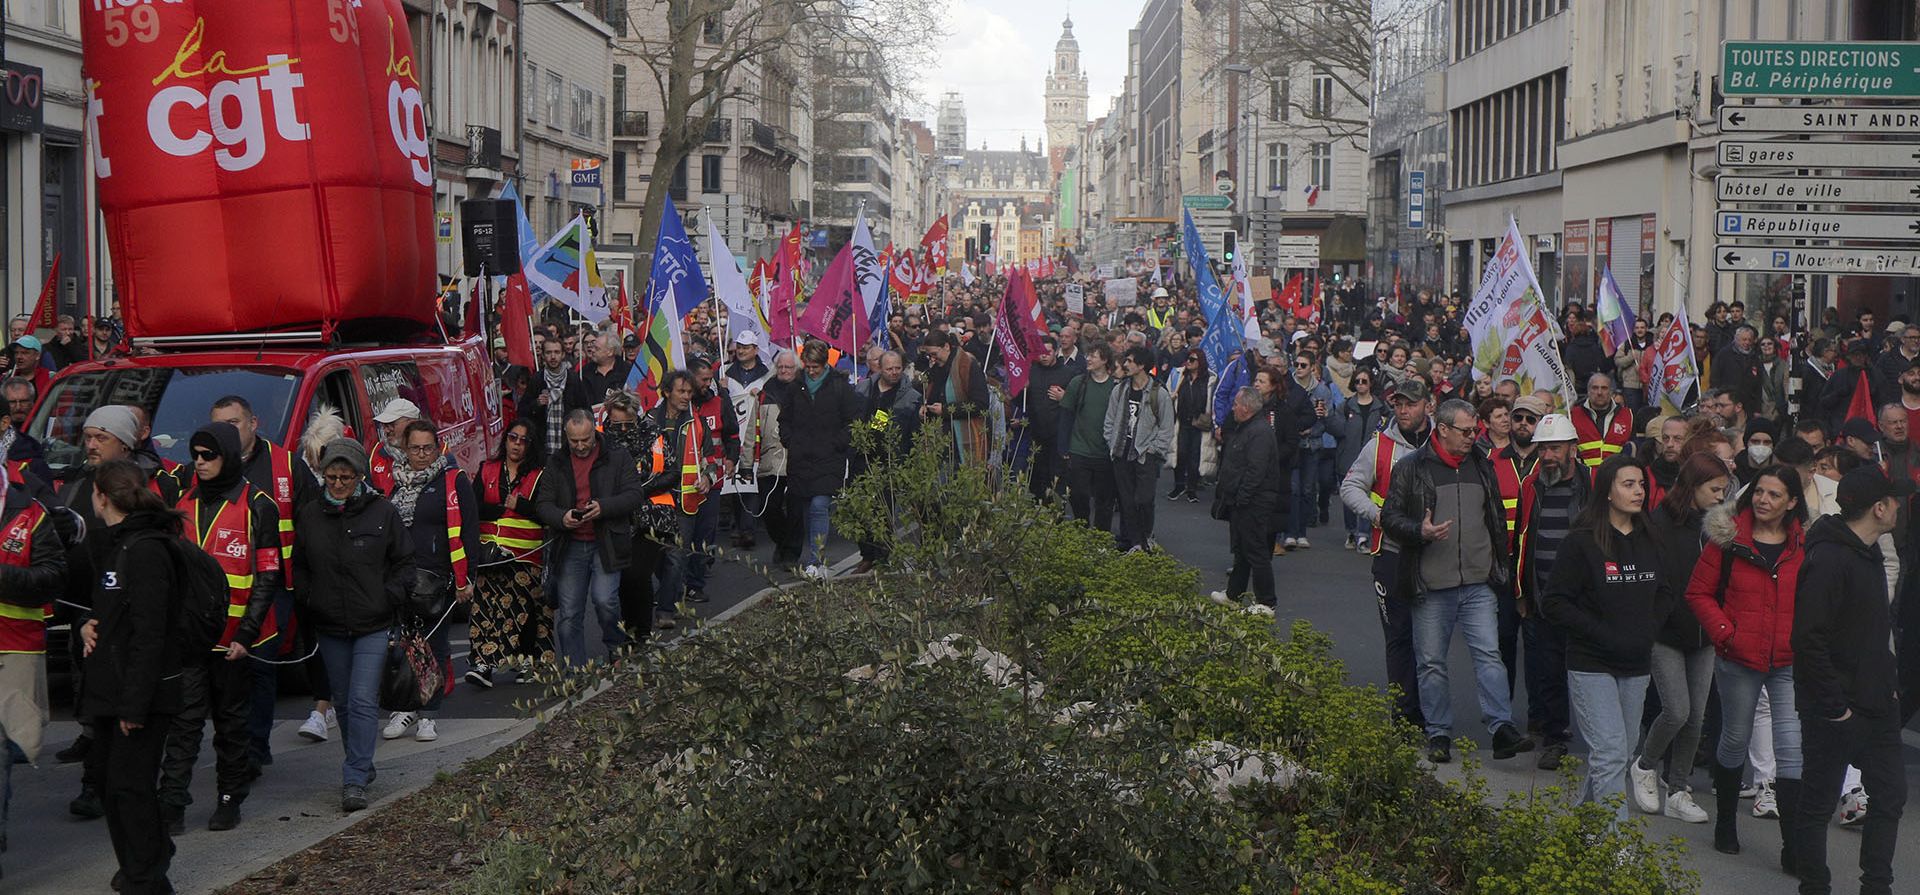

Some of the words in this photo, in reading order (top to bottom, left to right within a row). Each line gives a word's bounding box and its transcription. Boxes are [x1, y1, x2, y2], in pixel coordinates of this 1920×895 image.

[105, 5, 160, 47] 59
[152, 16, 301, 86] la
[386, 15, 420, 86] la
[1732, 50, 1794, 66] TOUTES
[1800, 50, 1900, 68] DIRECTIONS
[1730, 71, 1760, 88] Bd.
[1769, 71, 1893, 92] Périphérique
[147, 54, 311, 172] cgt
[1803, 113, 1858, 127] SAINT
[1749, 150, 1794, 163] gares
[573, 173, 598, 184] GMF
[1725, 183, 1767, 196] hôtel
[1776, 184, 1795, 196] de
[1805, 184, 1842, 197] ville
[1747, 218, 1841, 235] République
[10, 526, 29, 541] cgt
[226, 544, 248, 557] cgt
[104, 571, 118, 587] 3
